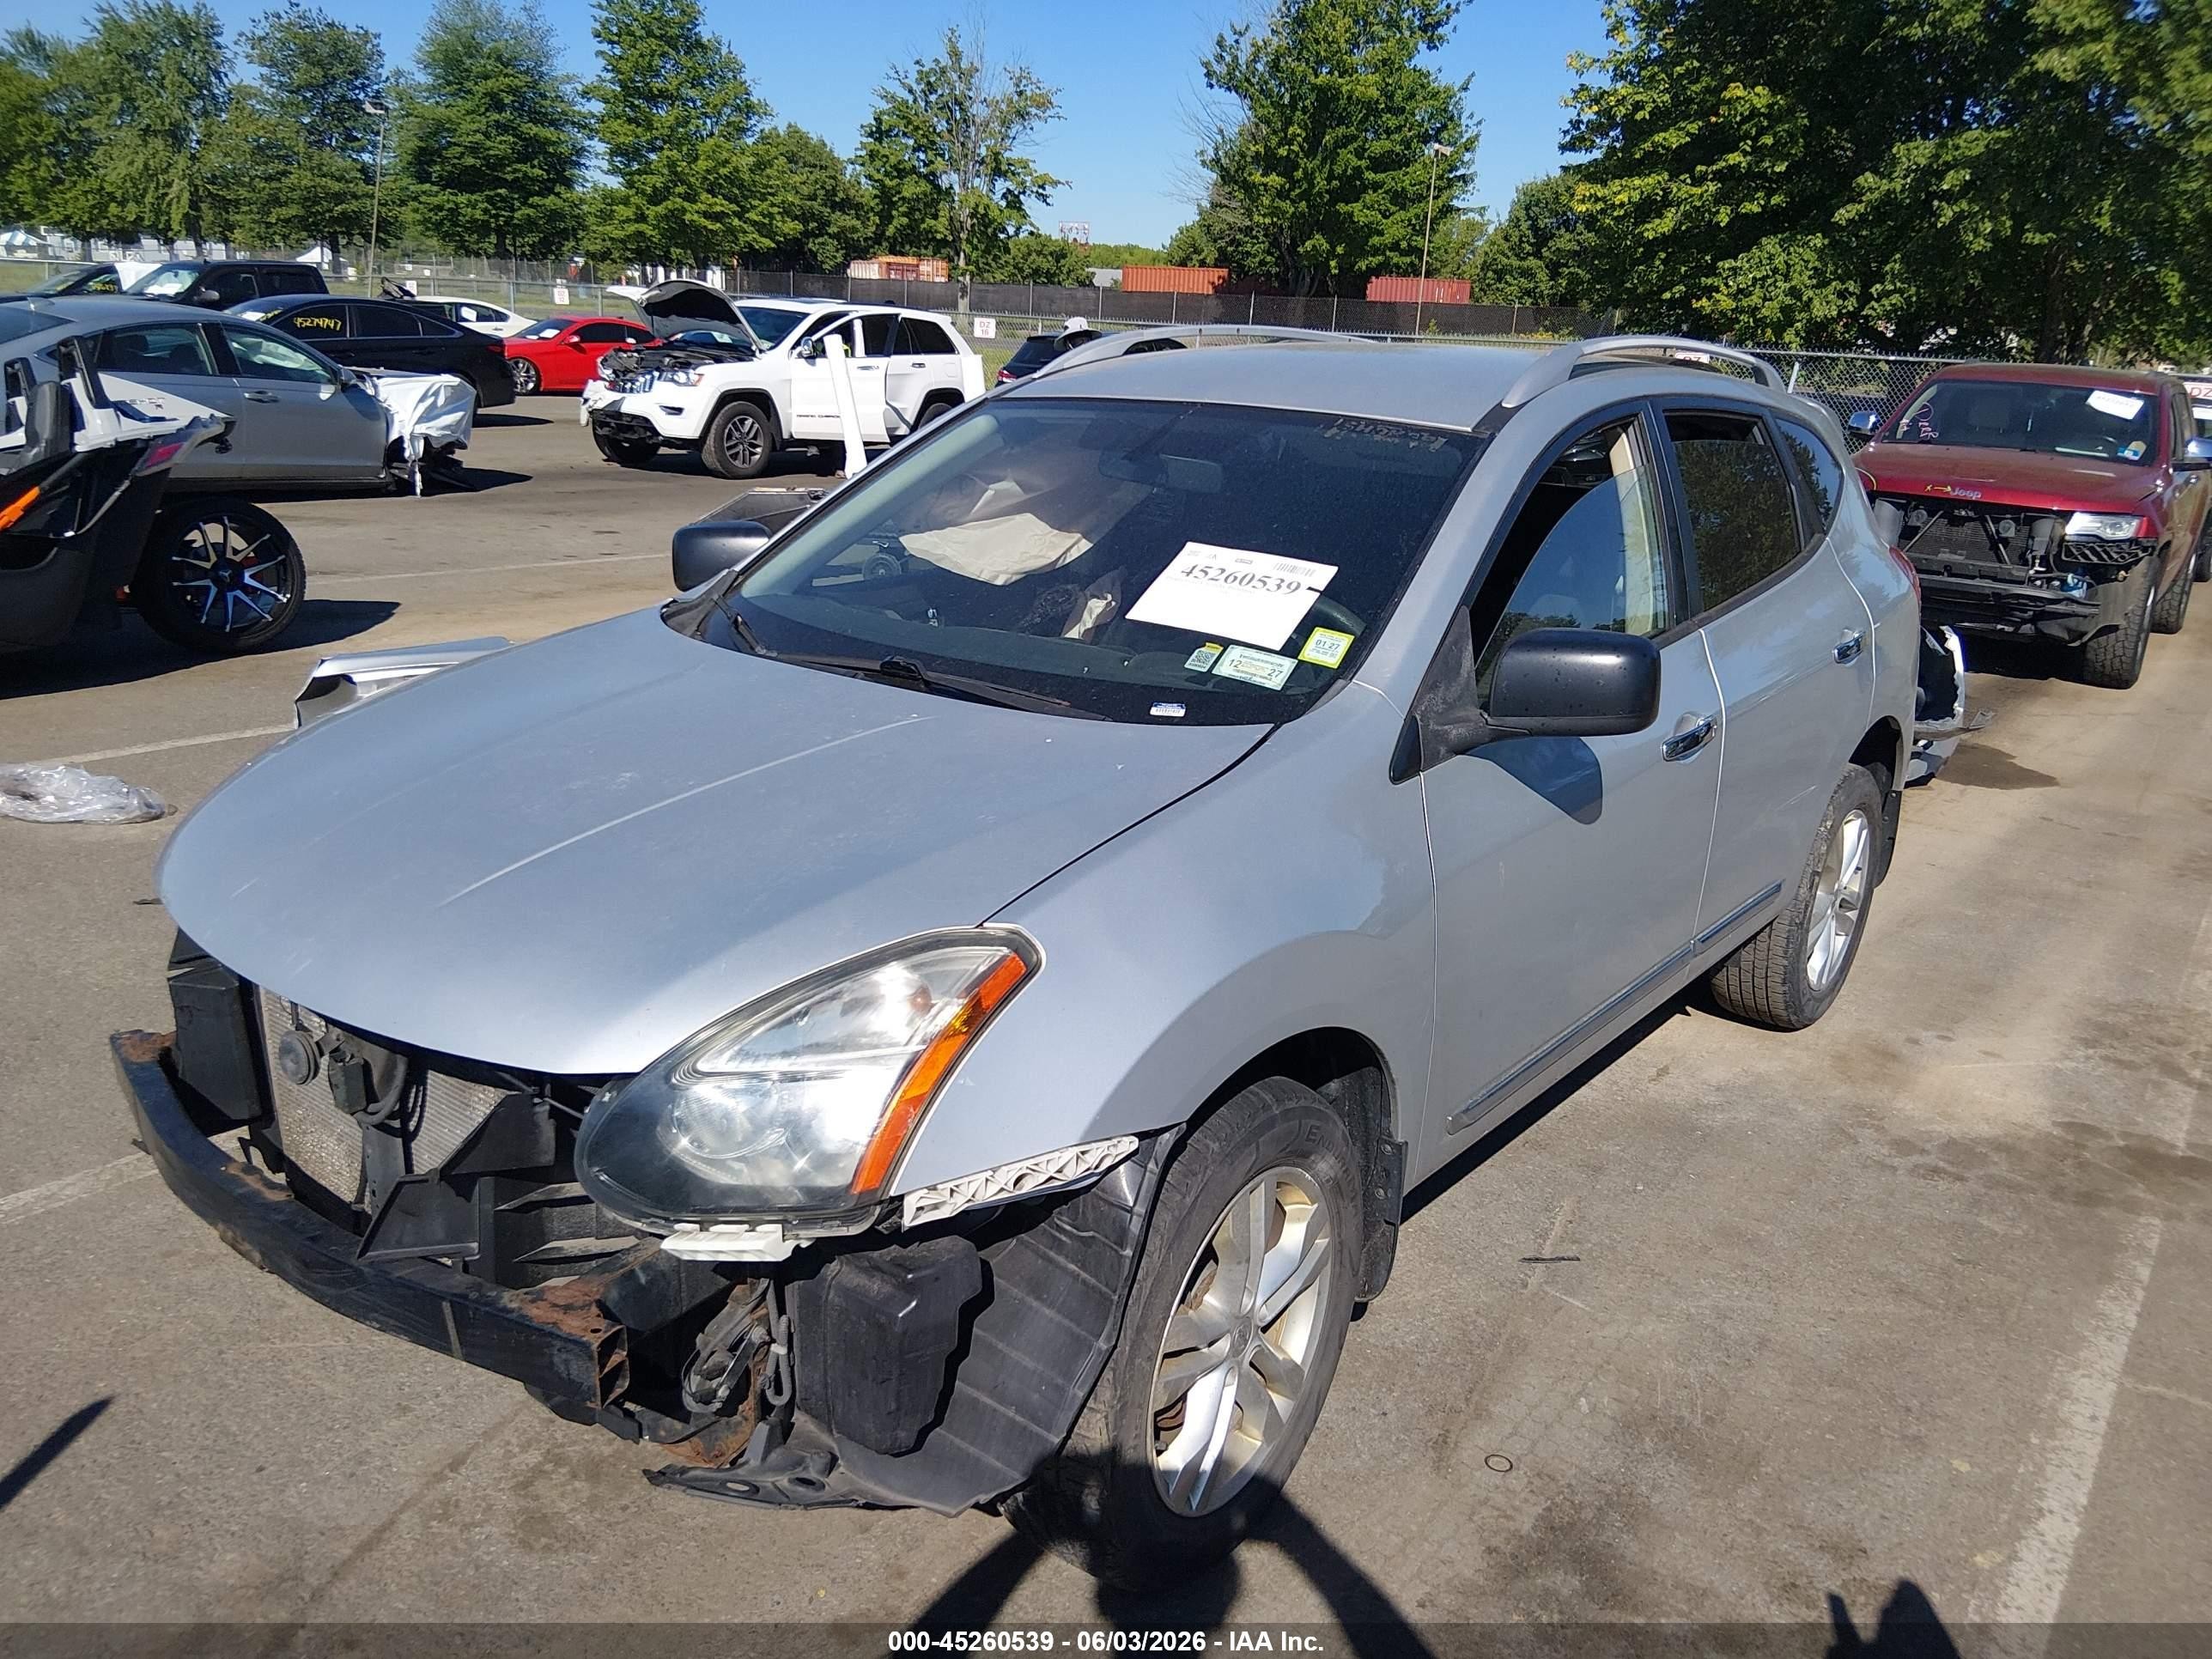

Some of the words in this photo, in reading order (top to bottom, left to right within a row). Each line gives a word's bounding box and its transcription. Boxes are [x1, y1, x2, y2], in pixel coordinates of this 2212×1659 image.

[1950, 487, 1982, 500] Jeep
[1181, 564, 1301, 595] 45260539
[1328, 642, 1340, 651] 27
[1228, 659, 1243, 669] 12
[1267, 668, 1284, 678] 27
